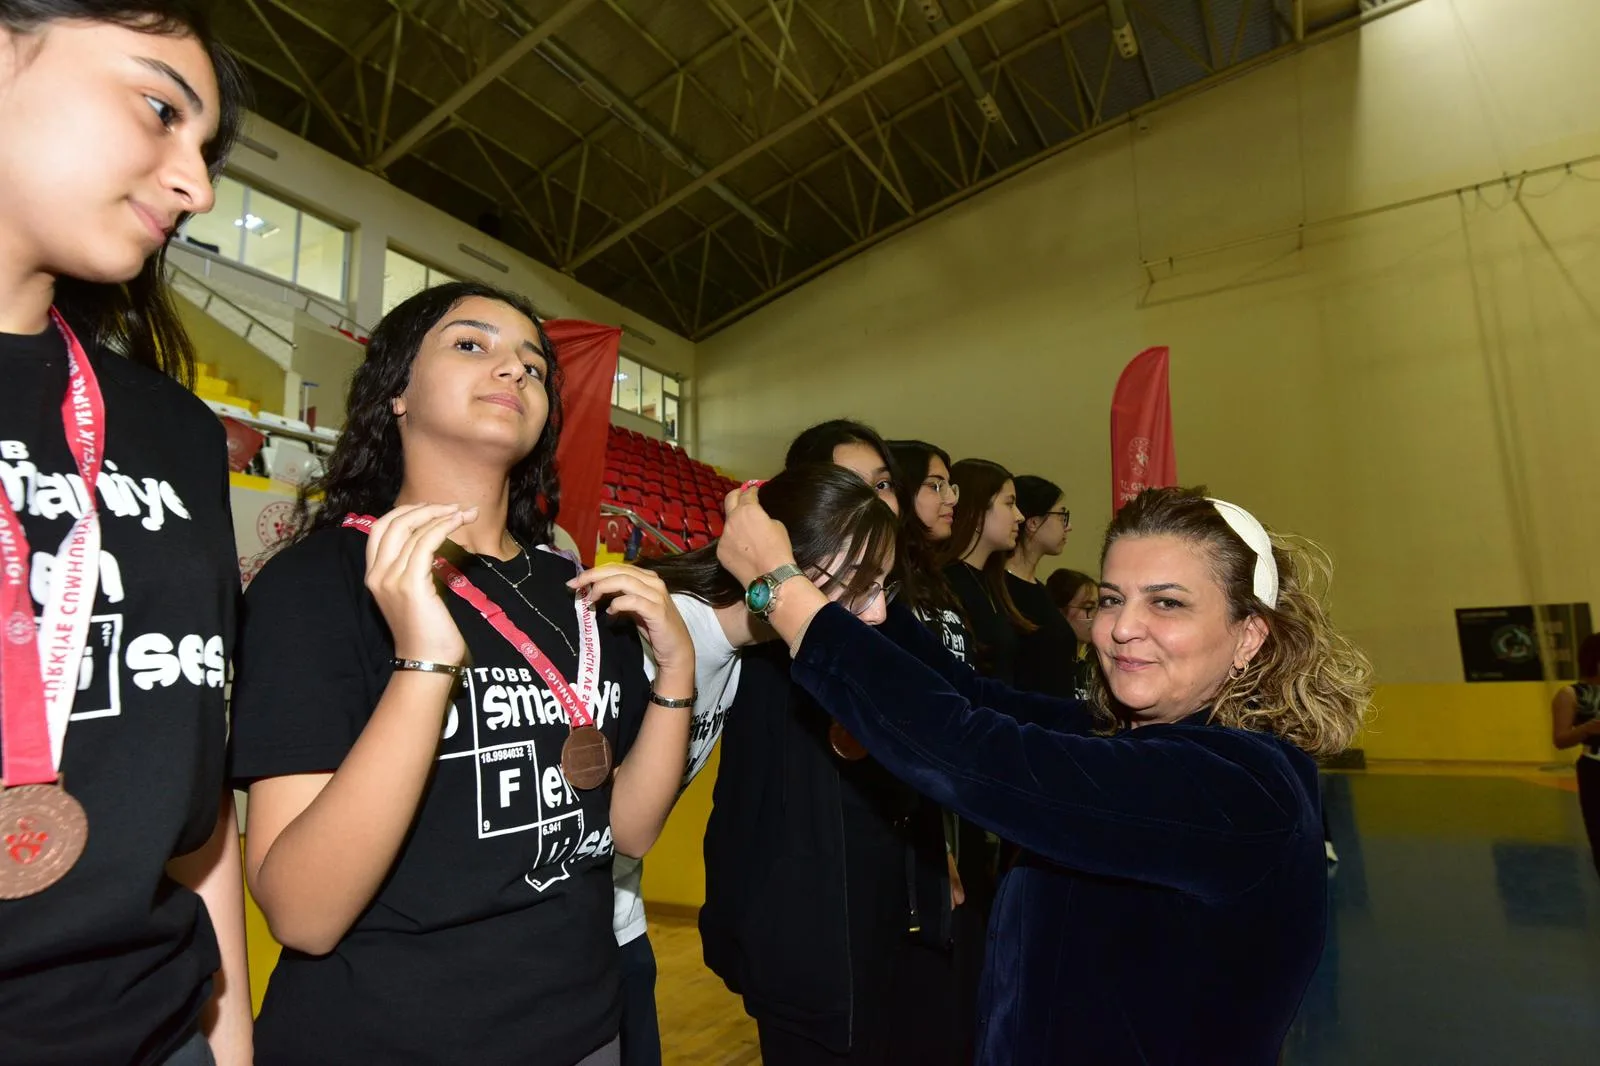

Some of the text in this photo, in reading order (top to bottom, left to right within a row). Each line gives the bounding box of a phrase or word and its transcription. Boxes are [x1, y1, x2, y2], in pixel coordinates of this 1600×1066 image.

[474, 667, 533, 683] TOBB
[545, 668, 587, 726] BAKANLIĞI
[480, 746, 525, 764] 18.9984032
[499, 768, 521, 808] F
[483, 820, 491, 831] 9
[542, 821, 561, 836] 6.941
